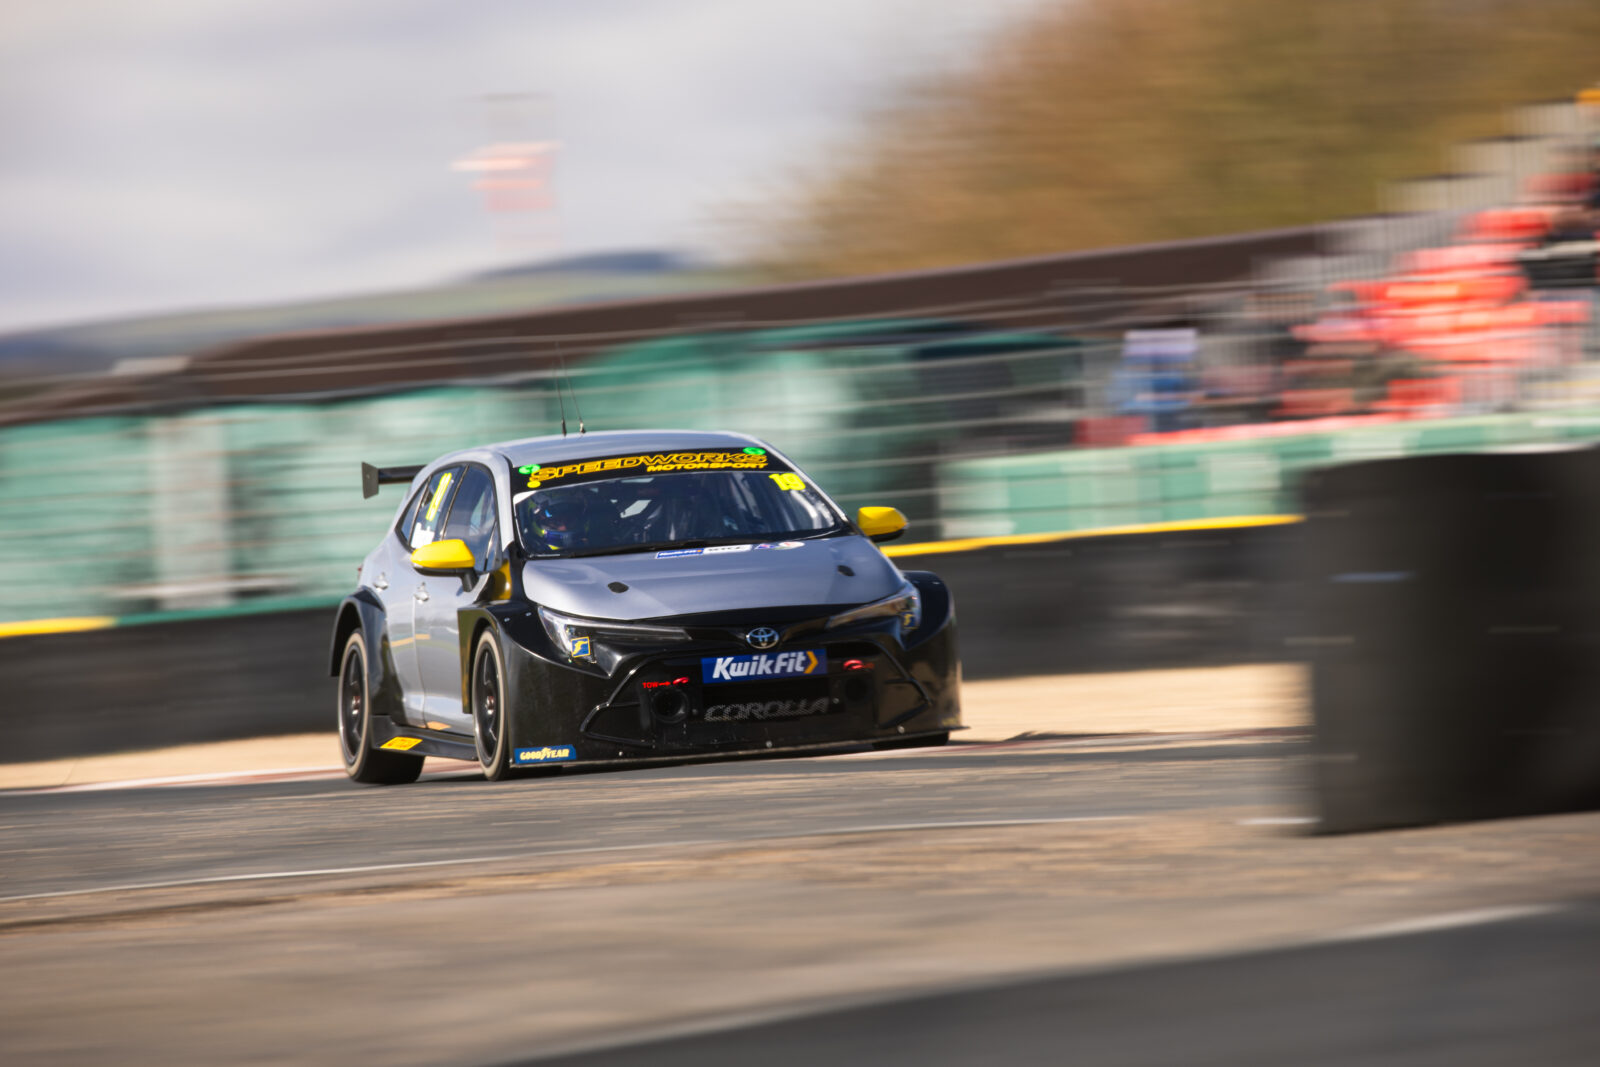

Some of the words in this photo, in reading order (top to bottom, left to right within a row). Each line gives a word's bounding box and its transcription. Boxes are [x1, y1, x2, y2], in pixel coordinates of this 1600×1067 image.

[646, 462, 768, 473] MOTORSPORT
[768, 472, 806, 491] 19
[642, 681, 659, 689] TOW
[704, 697, 830, 721] COROLLA
[520, 747, 570, 760] GOODYEAR
